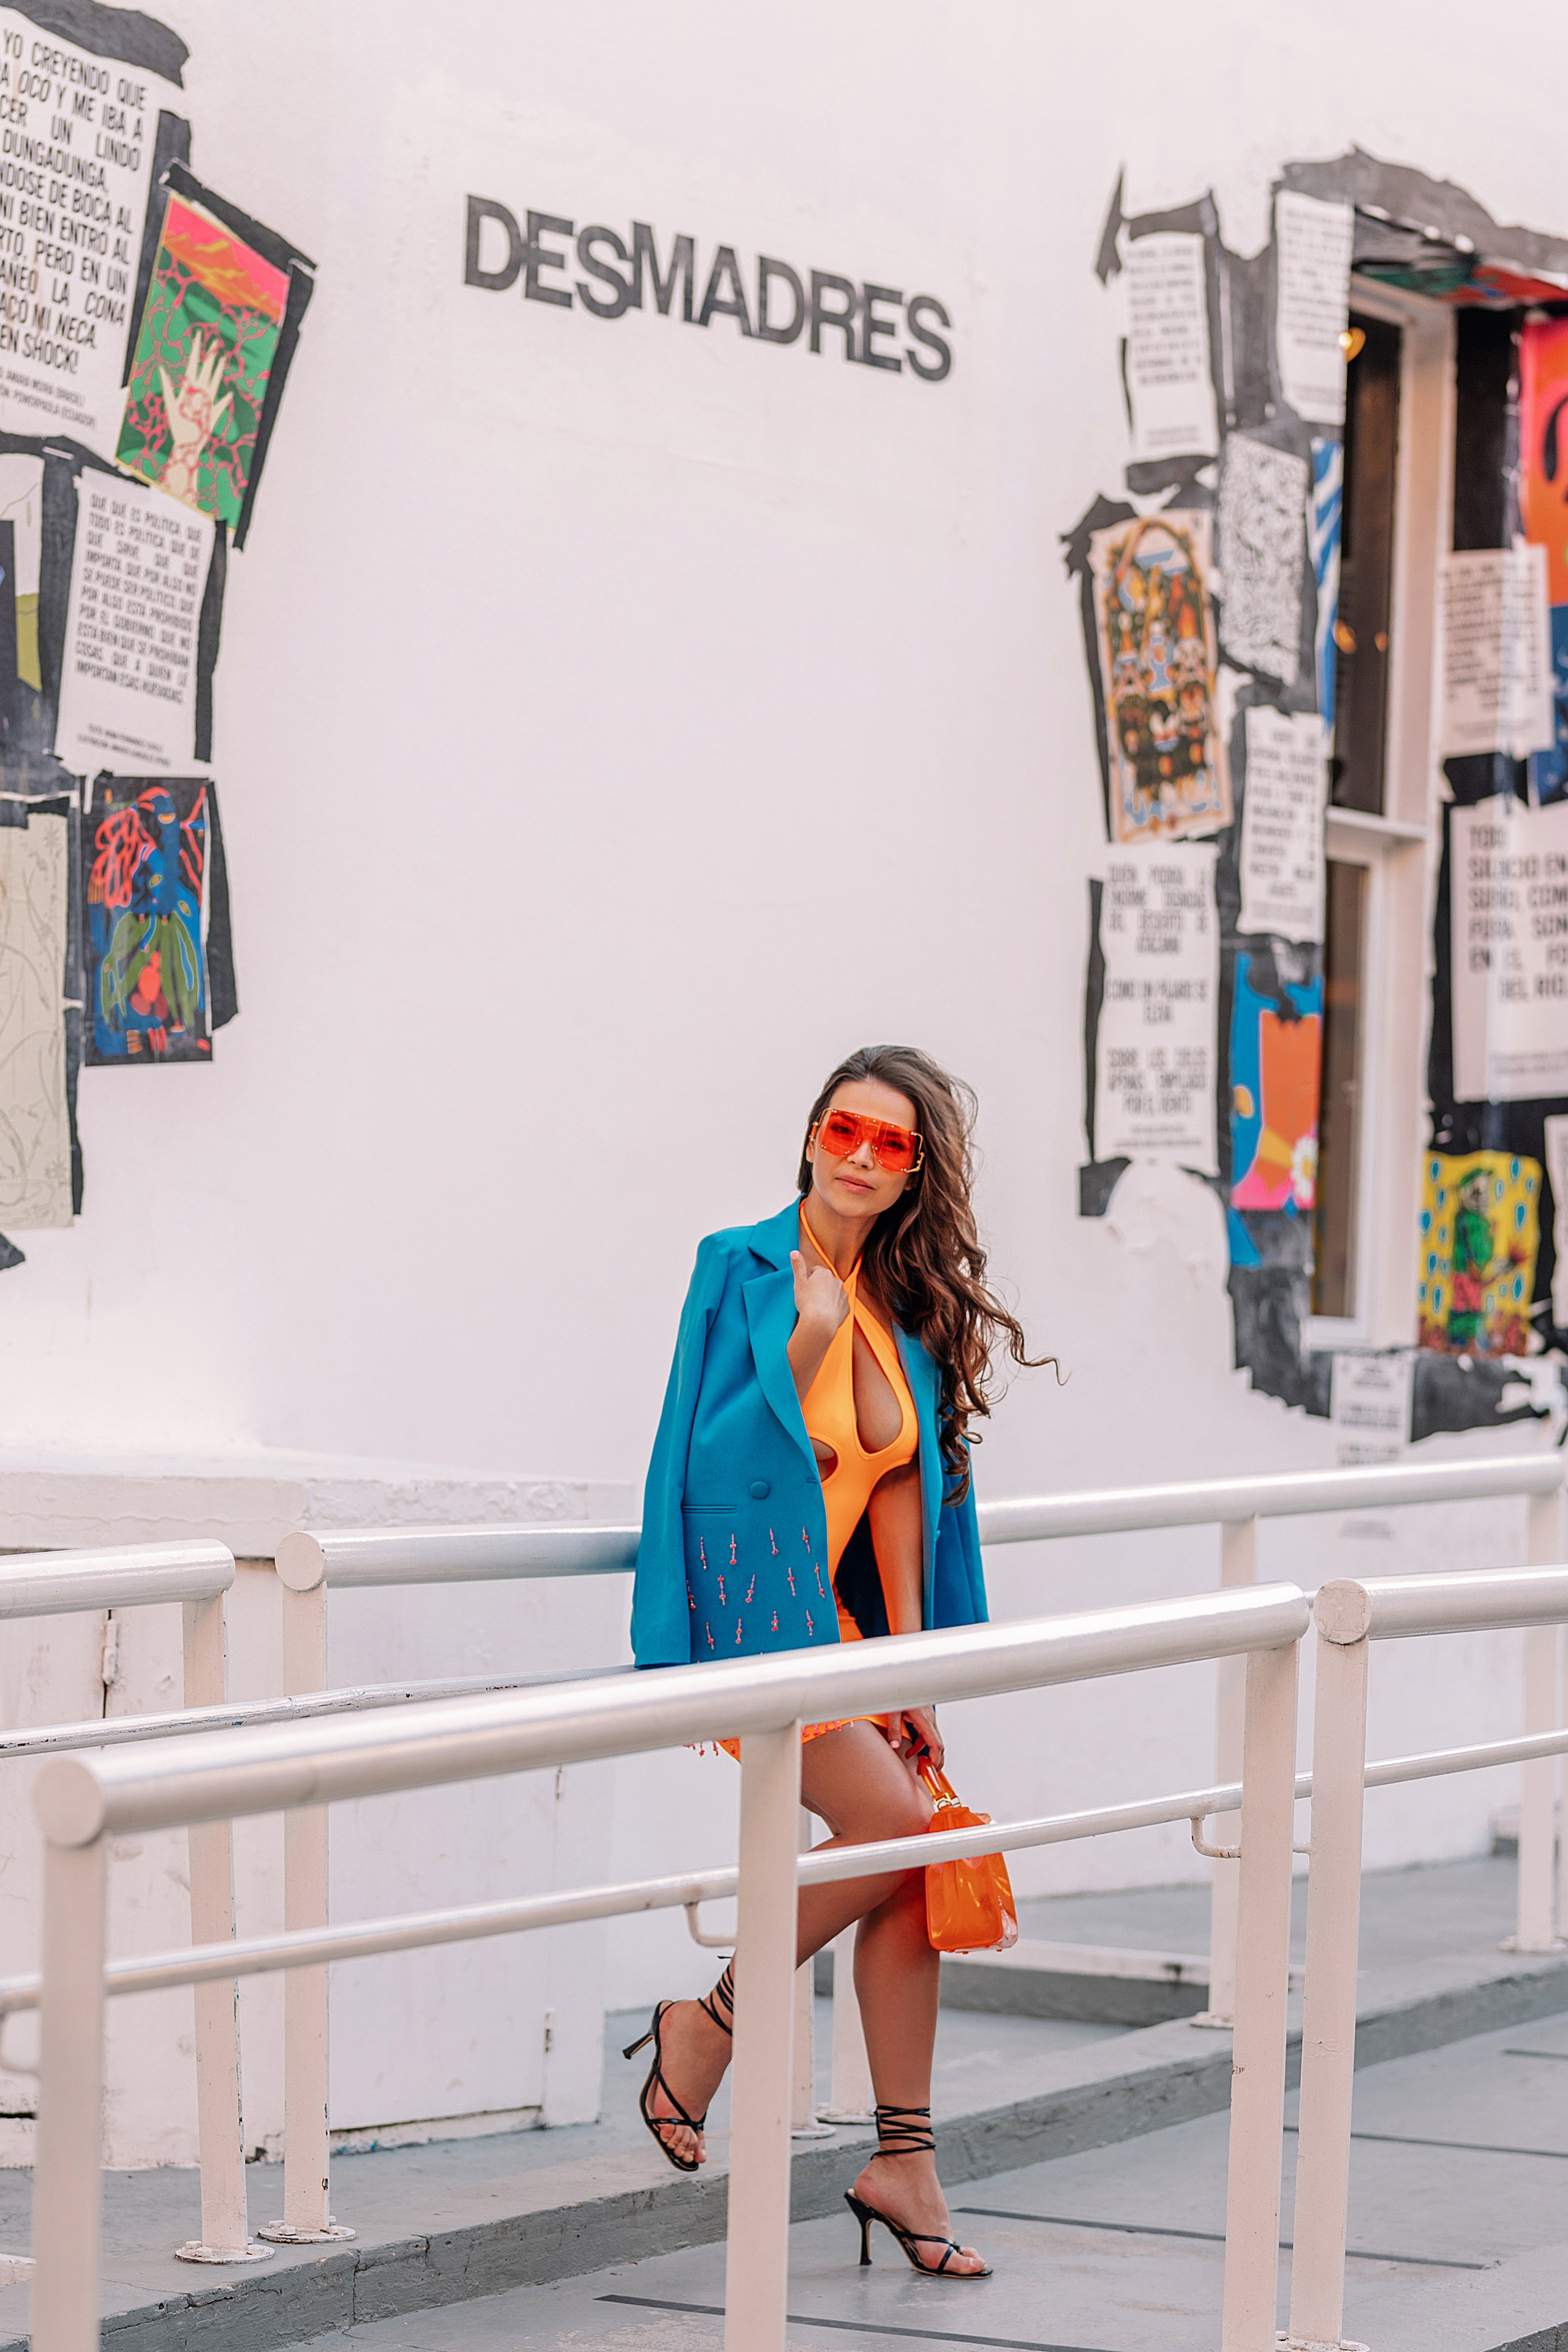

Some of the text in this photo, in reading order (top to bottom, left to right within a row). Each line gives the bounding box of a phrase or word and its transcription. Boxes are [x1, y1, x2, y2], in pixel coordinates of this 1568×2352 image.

[4, 29, 146, 111] YO CREYENDO QUE
[18, 70, 50, 102] OCO
[57, 85, 66, 109] Y
[73, 92, 96, 121] ME
[102, 104, 126, 135] IBA
[133, 118, 143, 141] A
[52, 115, 73, 145] UN
[96, 133, 140, 172] LINDO
[20, 201, 55, 235] BIEN
[112, 238, 130, 265] AL
[49, 180, 68, 208] DE
[72, 189, 111, 227] BOCA
[116, 207, 132, 234] AL
[34, 239, 74, 275] PERO
[81, 257, 101, 285] EN
[107, 266, 128, 295] UN
[52, 277, 69, 306] LA
[464, 194, 952, 382] DESMADRES
[32, 303, 51, 333] MI
[23, 333, 78, 374] SHOCK!
